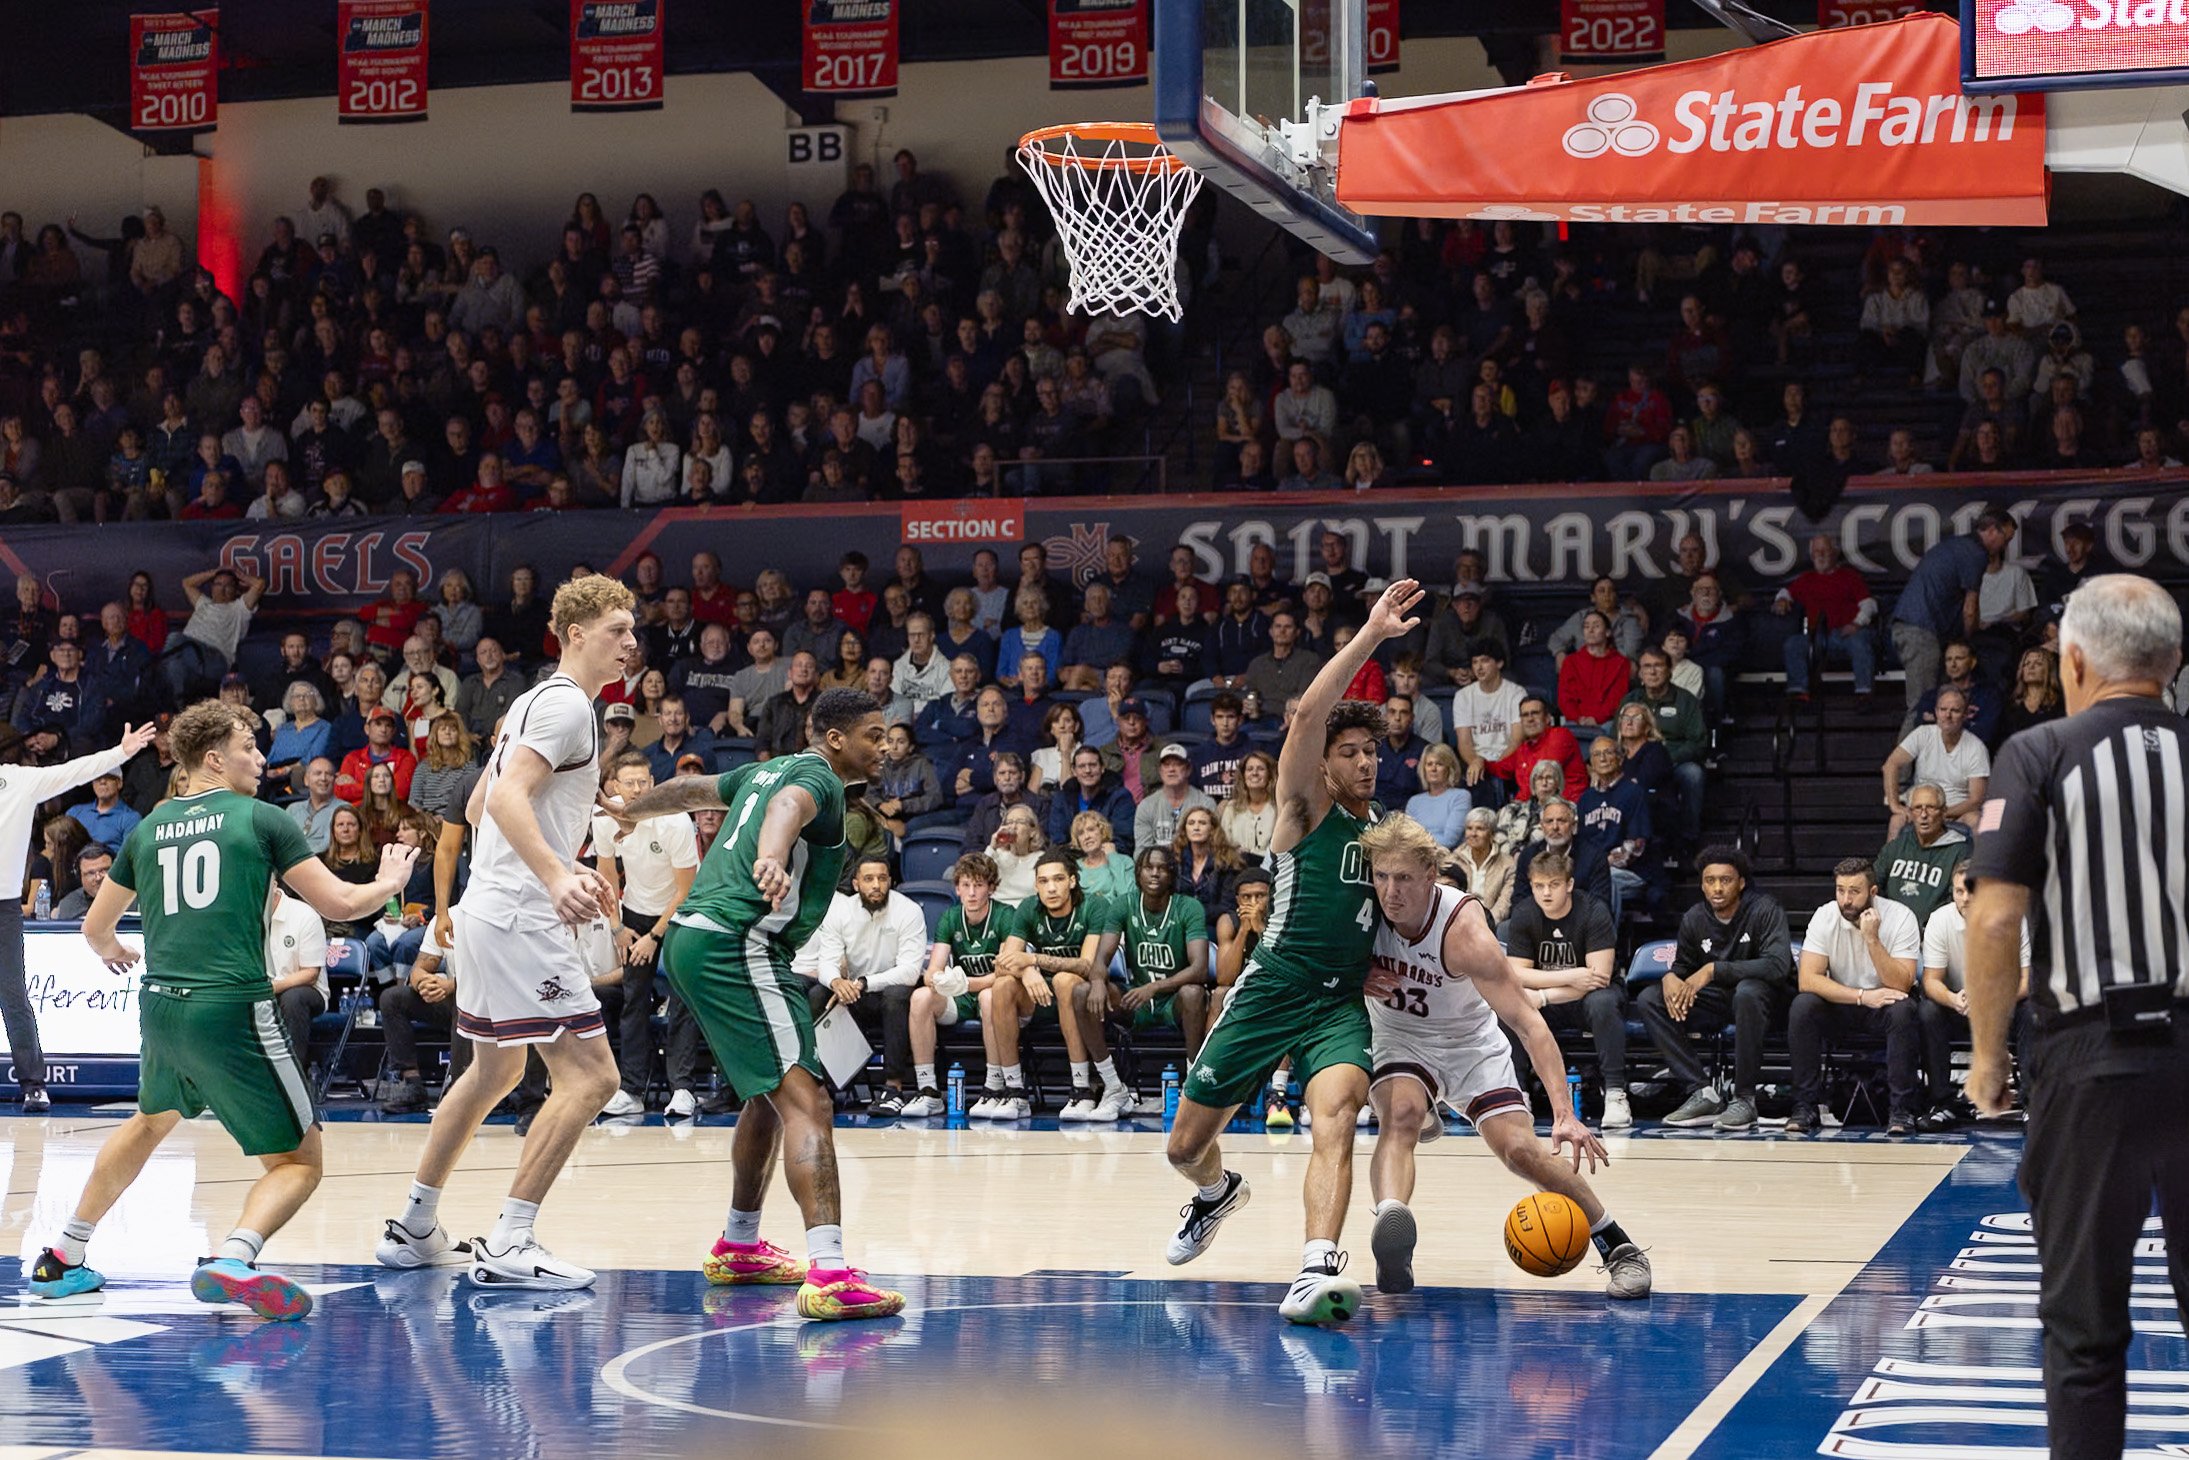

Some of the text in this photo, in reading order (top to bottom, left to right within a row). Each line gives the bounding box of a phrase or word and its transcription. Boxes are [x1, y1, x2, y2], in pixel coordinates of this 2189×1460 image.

[362, 18, 402, 32] MARCH
[595, 4, 637, 19] MARCH
[600, 16, 656, 32] MADNESS
[832, 2, 890, 20] MADNESS
[154, 32, 192, 47] MARCH
[366, 30, 419, 46] MADNESS
[1570, 15, 1657, 50] 2022
[158, 42, 210, 60] MADNESS
[1061, 41, 1136, 76] 2019
[581, 66, 653, 99] 2013
[814, 53, 887, 87] 2017
[141, 91, 207, 124] 2010
[349, 79, 417, 111] 2012
[788, 132, 842, 163] BB
[907, 518, 1015, 539] SECTION C
[220, 531, 433, 595] GAELS
[155, 813, 225, 841] HADAWAY
[722, 791, 760, 851] 1
[157, 839, 221, 916] 10
[1889, 858, 1943, 888] OHIO
[1355, 897, 1374, 932] 4
[1137, 941, 1175, 970] OHIO
[1398, 960, 1444, 988] MARY'S
[8, 1065, 79, 1083] CURT
